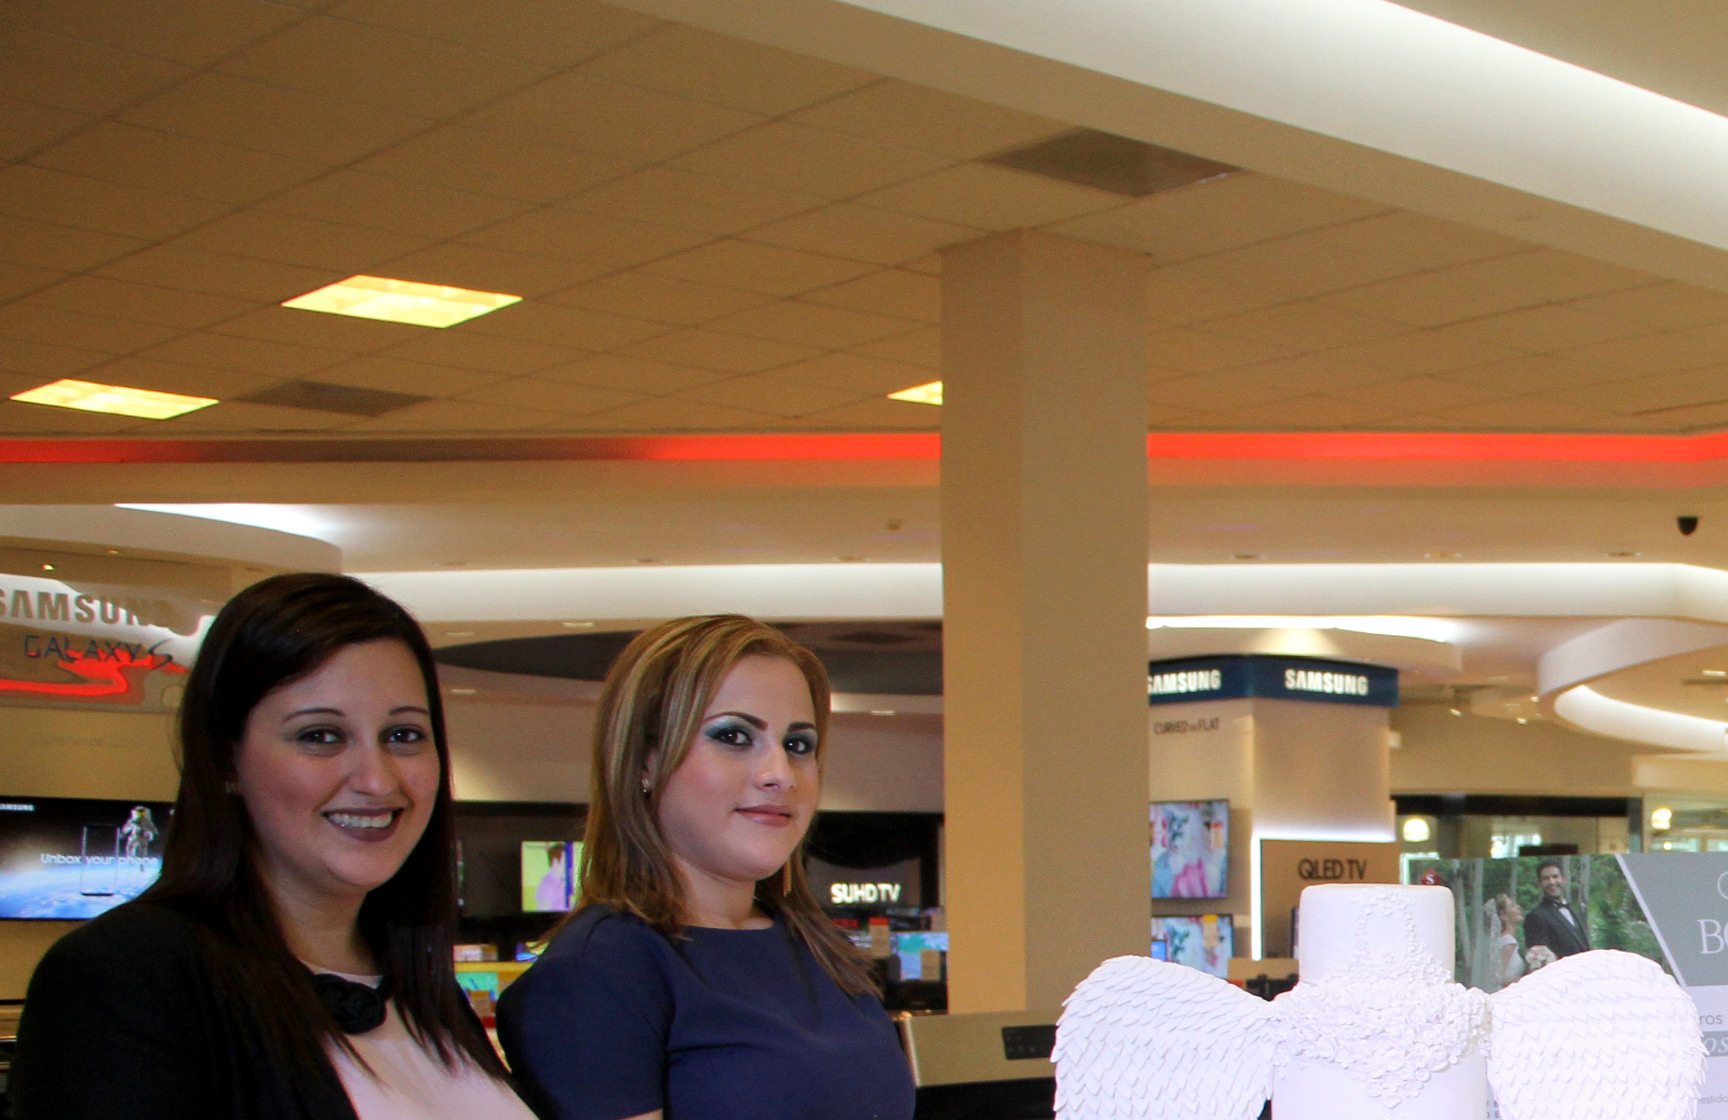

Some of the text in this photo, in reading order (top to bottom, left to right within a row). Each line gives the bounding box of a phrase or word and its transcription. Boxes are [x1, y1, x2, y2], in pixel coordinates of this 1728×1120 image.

[24, 634, 142, 664] GALAXY
[1285, 668, 1369, 696] SAMSUNG
[40, 853, 83, 864] Unbox
[86, 855, 117, 868] your
[1297, 858, 1368, 881] QLED TV
[830, 882, 901, 904] SUHD TV
